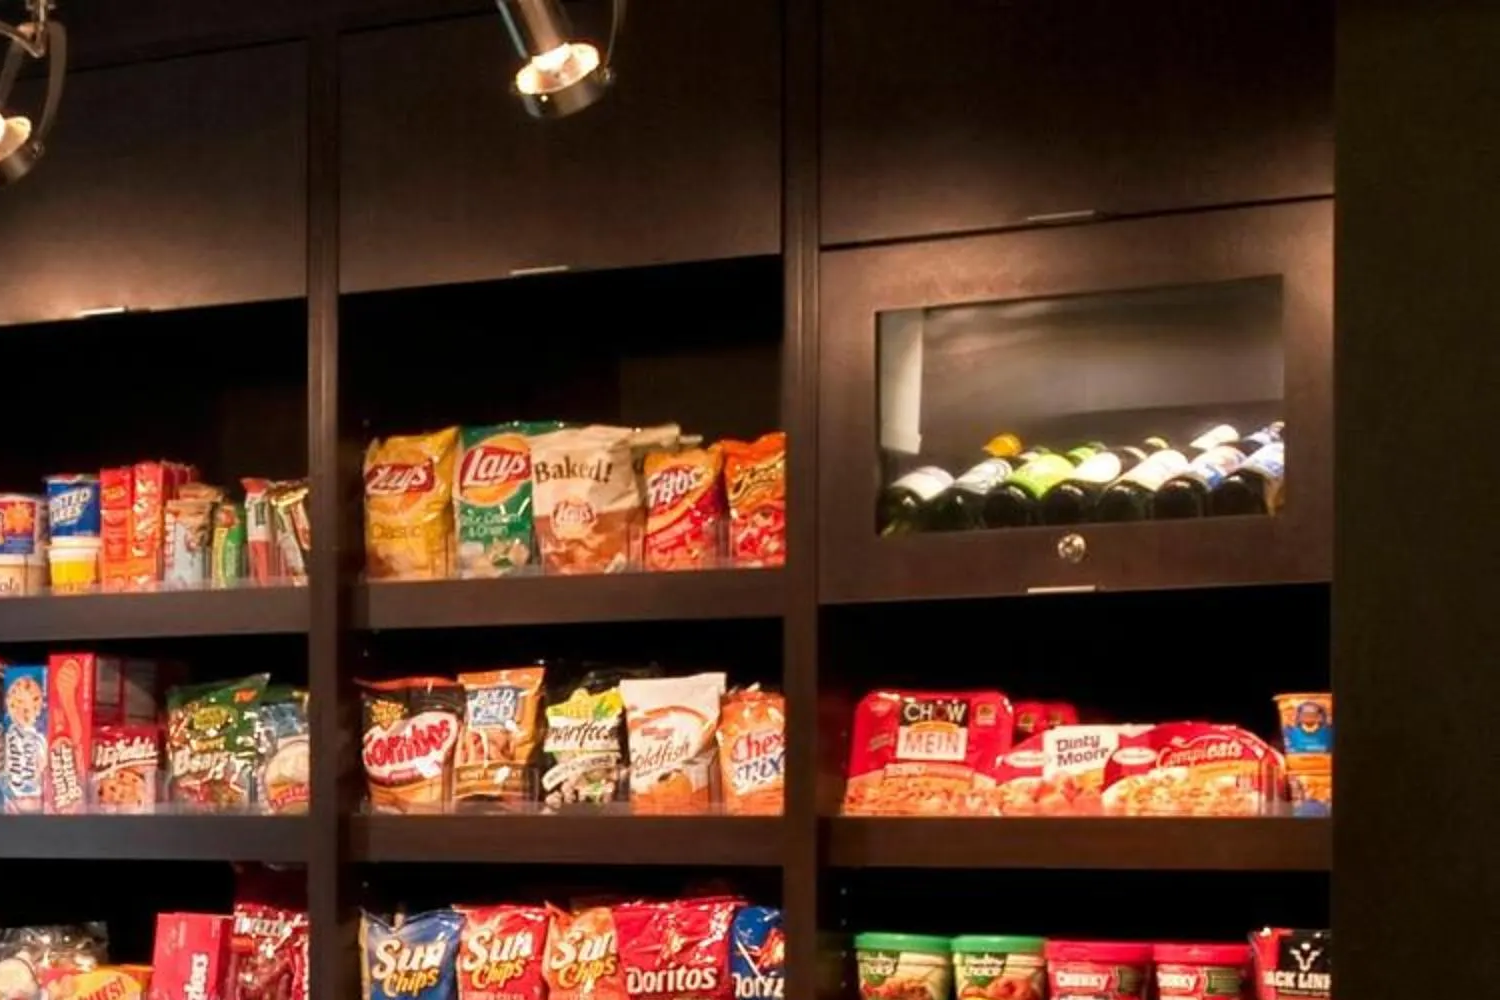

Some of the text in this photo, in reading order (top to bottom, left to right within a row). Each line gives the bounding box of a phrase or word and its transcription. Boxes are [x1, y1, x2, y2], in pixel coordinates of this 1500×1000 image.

[534, 456, 614, 484] Baked!
[904, 702, 968, 722] CHOW
[905, 731, 961, 754] MEIN
[1055, 733, 1102, 751] Dinty
[1056, 746, 1110, 767] Moore
[371, 938, 448, 980] Sun
[462, 930, 534, 971] Sun
[383, 967, 441, 998] Chips
[470, 958, 526, 989] Chips
[625, 962, 719, 994] Doritos
